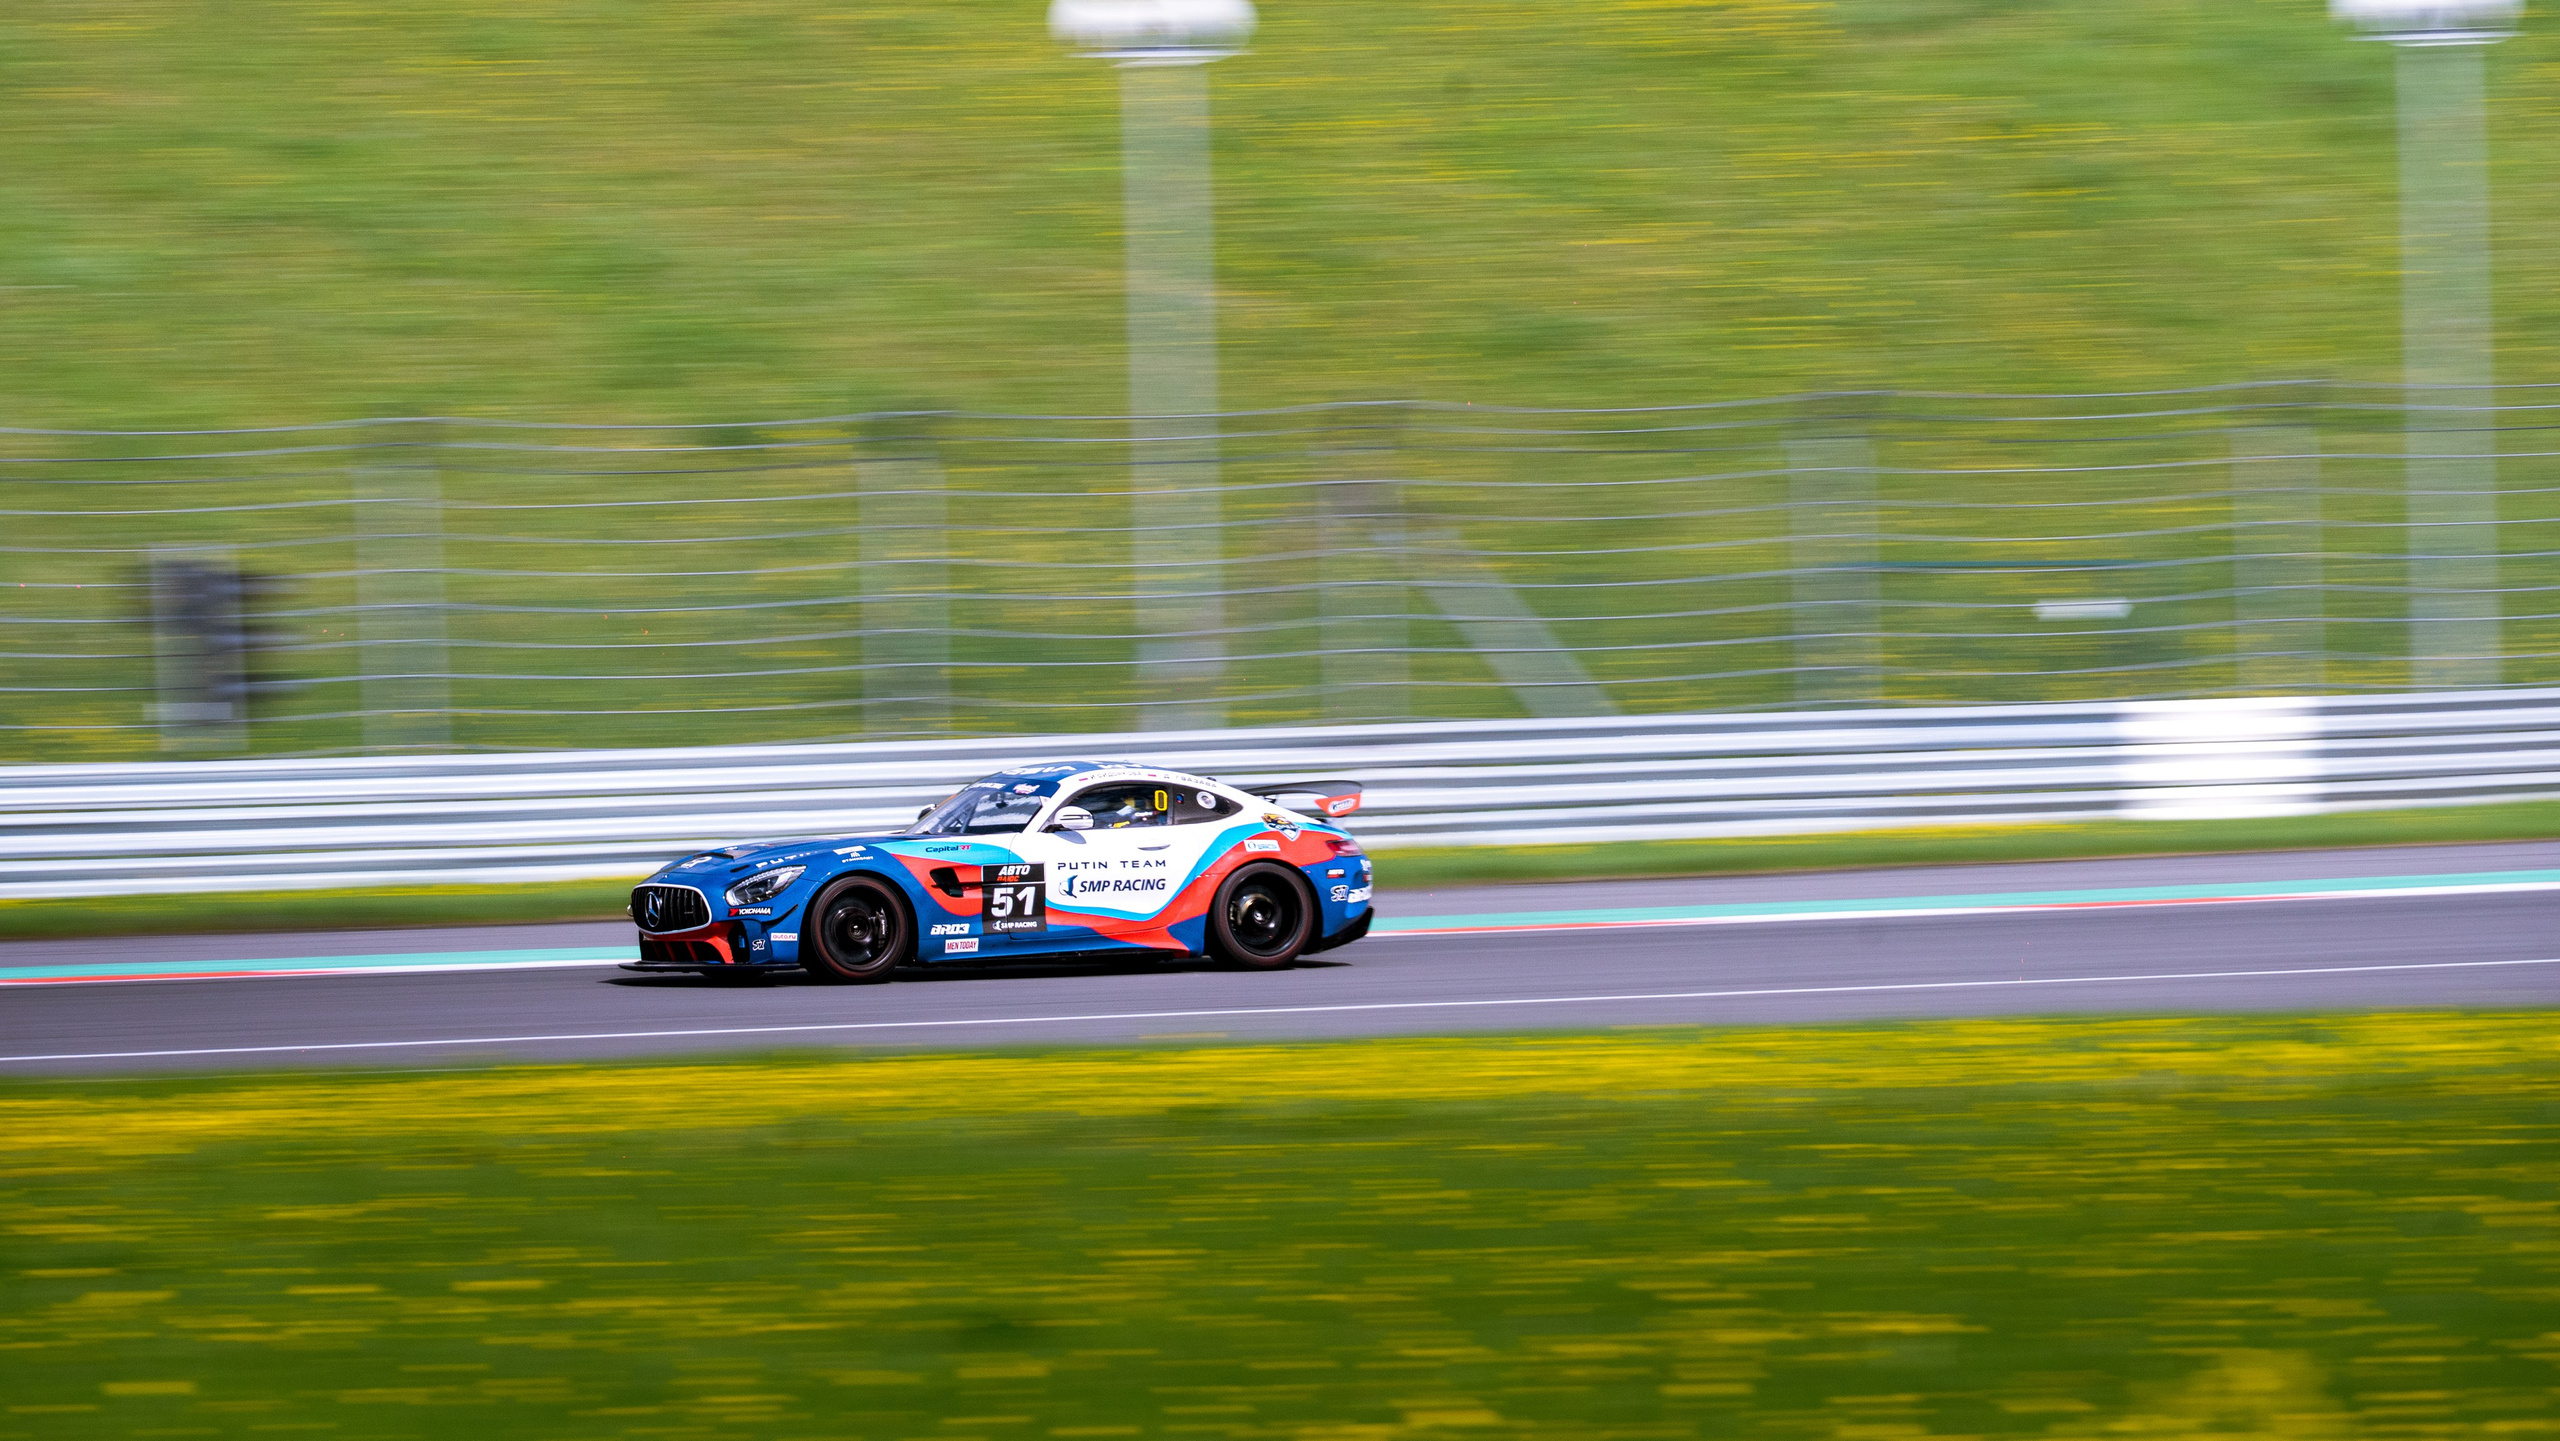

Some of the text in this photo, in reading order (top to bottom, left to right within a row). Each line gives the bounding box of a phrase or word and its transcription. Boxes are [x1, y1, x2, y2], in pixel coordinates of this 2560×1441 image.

[1057, 860, 1166, 870] PUTIN TEAM
[1079, 878, 1166, 893] SMP RACING
[991, 886, 1036, 918] 51
[739, 907, 771, 915] YOKOHAMA
[947, 941, 978, 950] MEN TODAY
